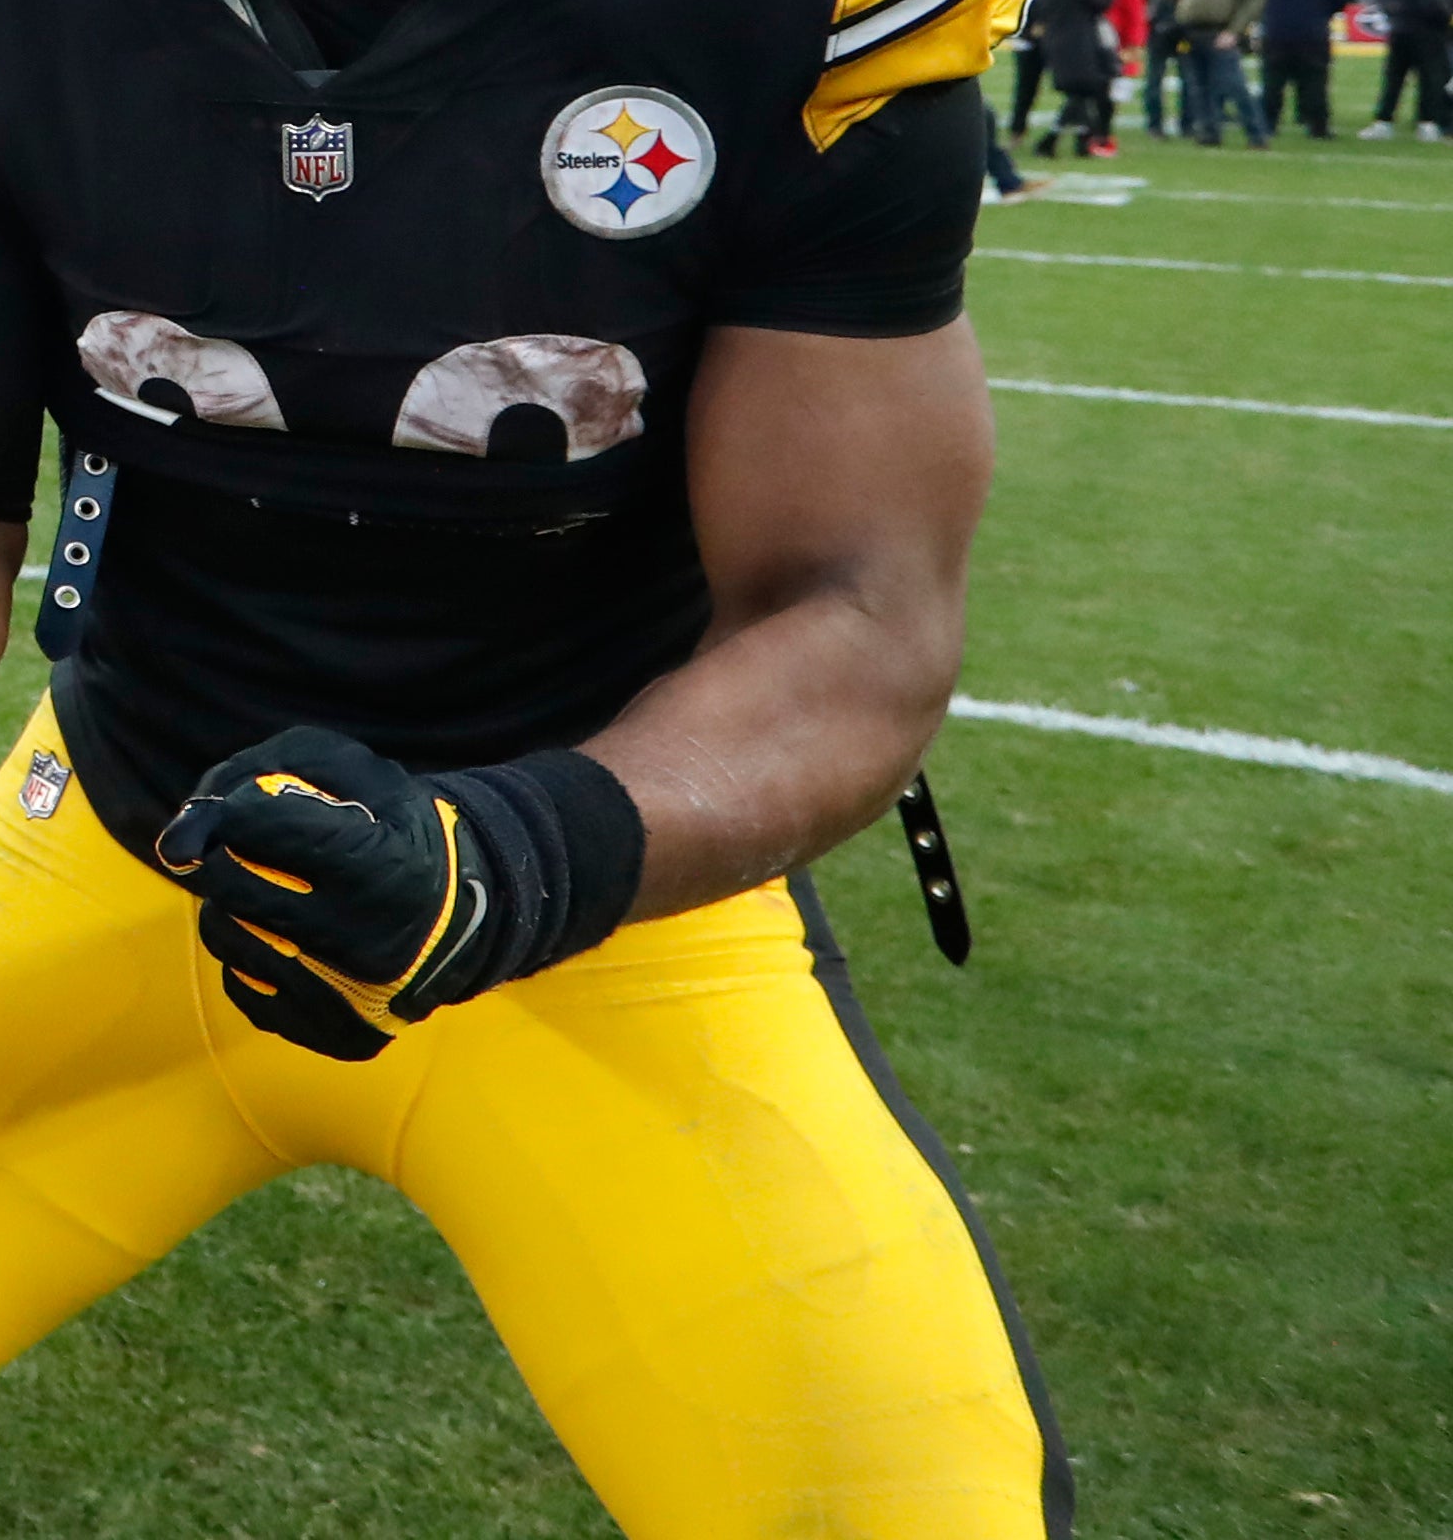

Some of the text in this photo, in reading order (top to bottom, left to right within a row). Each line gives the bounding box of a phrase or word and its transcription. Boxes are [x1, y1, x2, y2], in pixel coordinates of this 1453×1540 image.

[295, 155, 343, 186] NFL
[556, 151, 620, 170] Steelers
[25, 776, 52, 810] NFL
